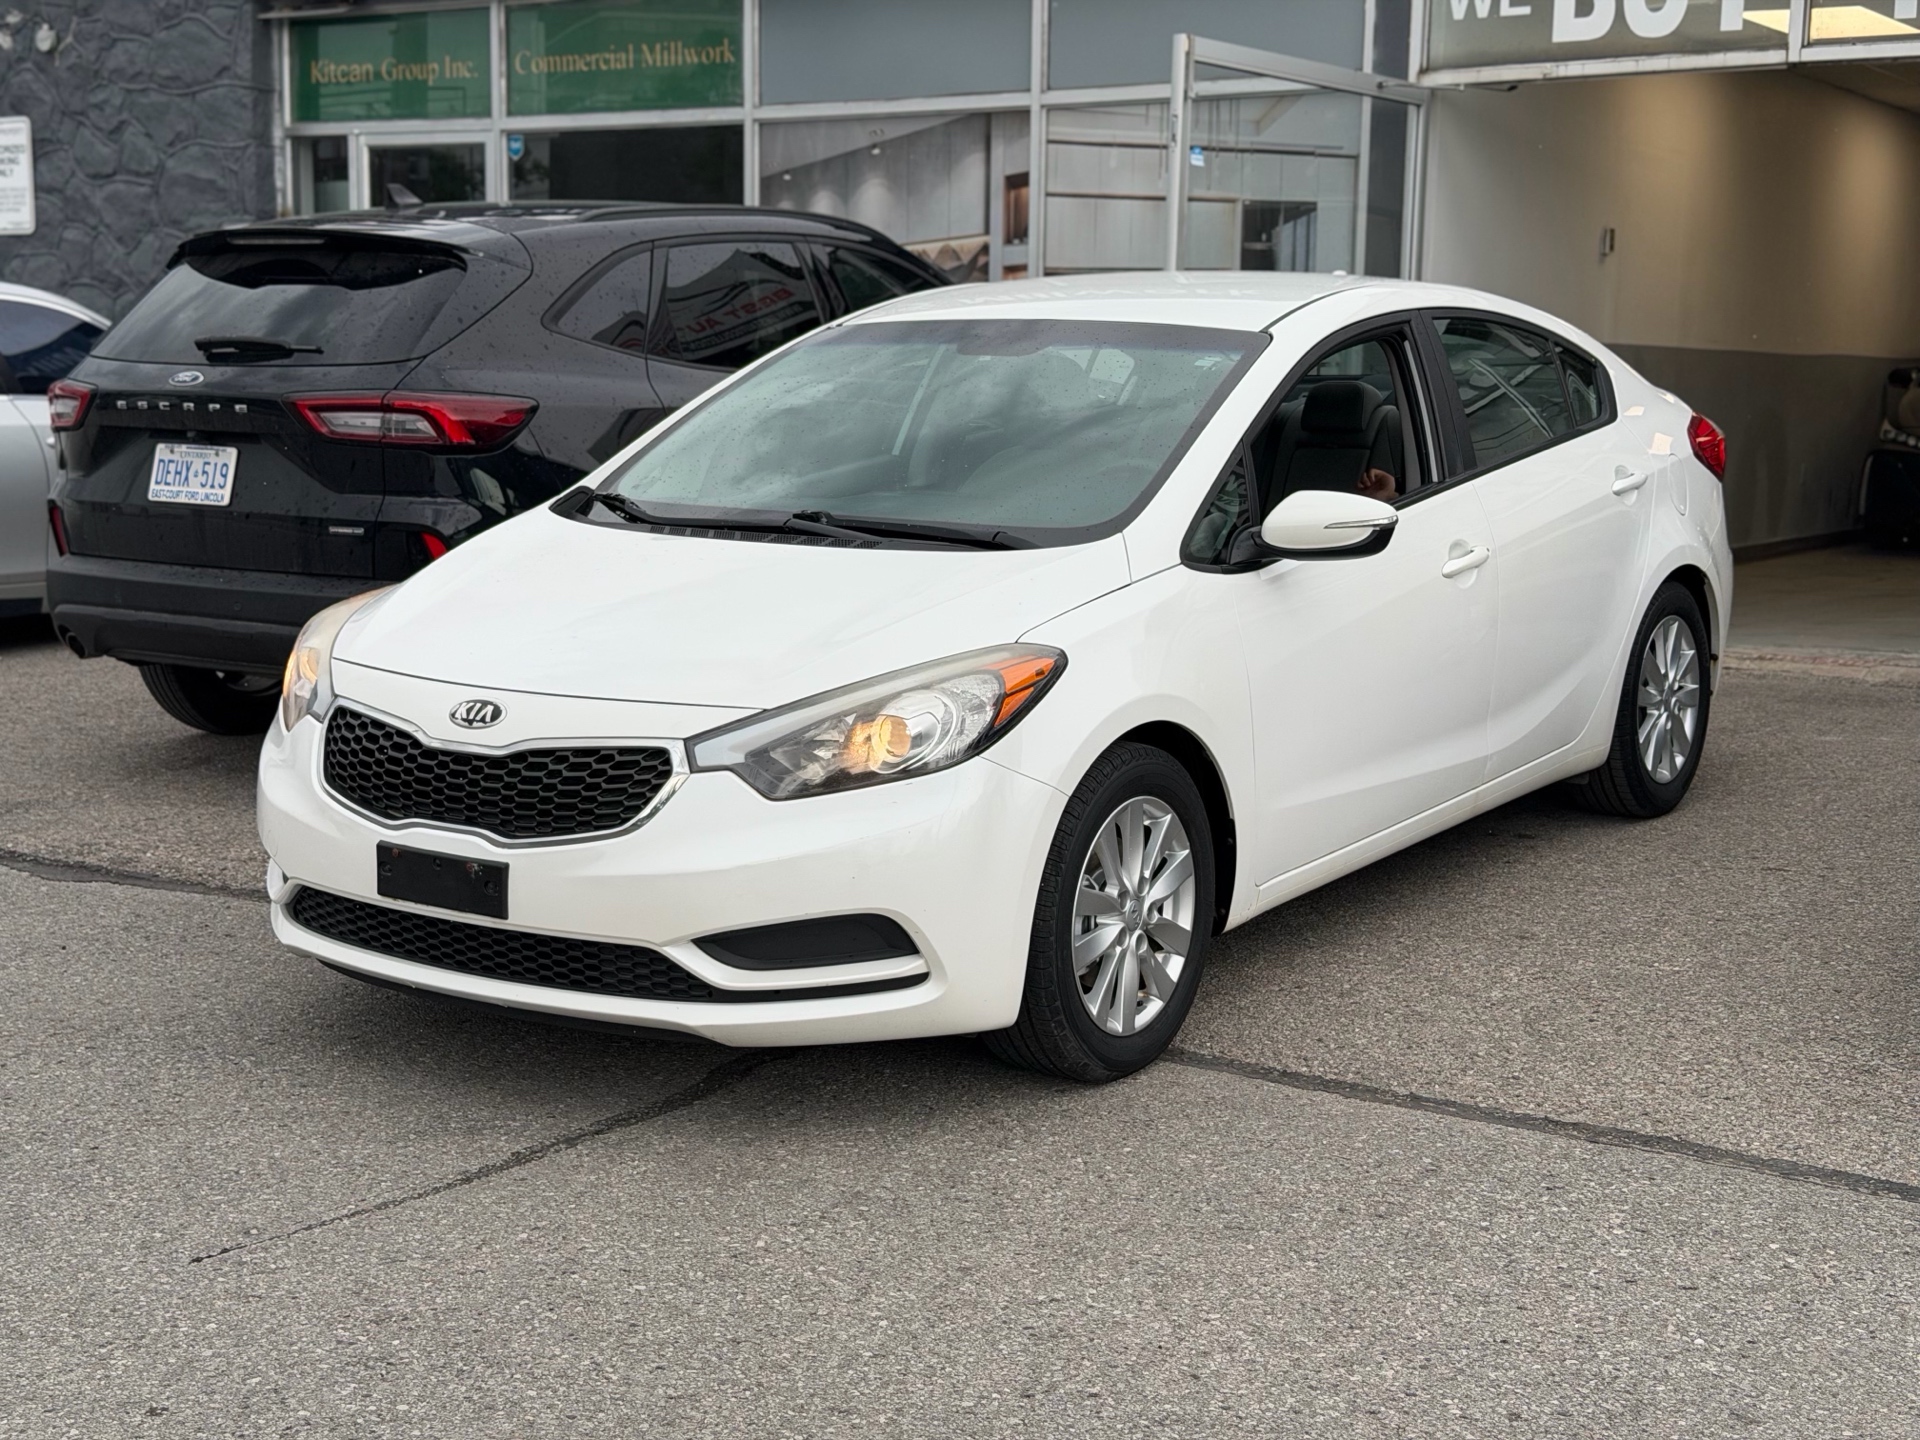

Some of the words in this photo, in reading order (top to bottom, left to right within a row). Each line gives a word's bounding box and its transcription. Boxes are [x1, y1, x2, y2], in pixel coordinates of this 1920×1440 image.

[513, 43, 634, 75] Commercial
[641, 38, 735, 68] Millwork
[310, 58, 374, 84] Kitcan
[380, 55, 439, 87] Group
[444, 55, 479, 79] Inc.
[116, 400, 248, 413] ESCAPE
[180, 450, 212, 460] ONTARIO
[154, 458, 193, 488] DEHX
[200, 461, 229, 489] 519
[151, 488, 185, 500] EAST-COURT
[185, 490, 199, 501] FORD
[200, 491, 225, 503] LINCOLN
[454, 702, 495, 723] KIA
